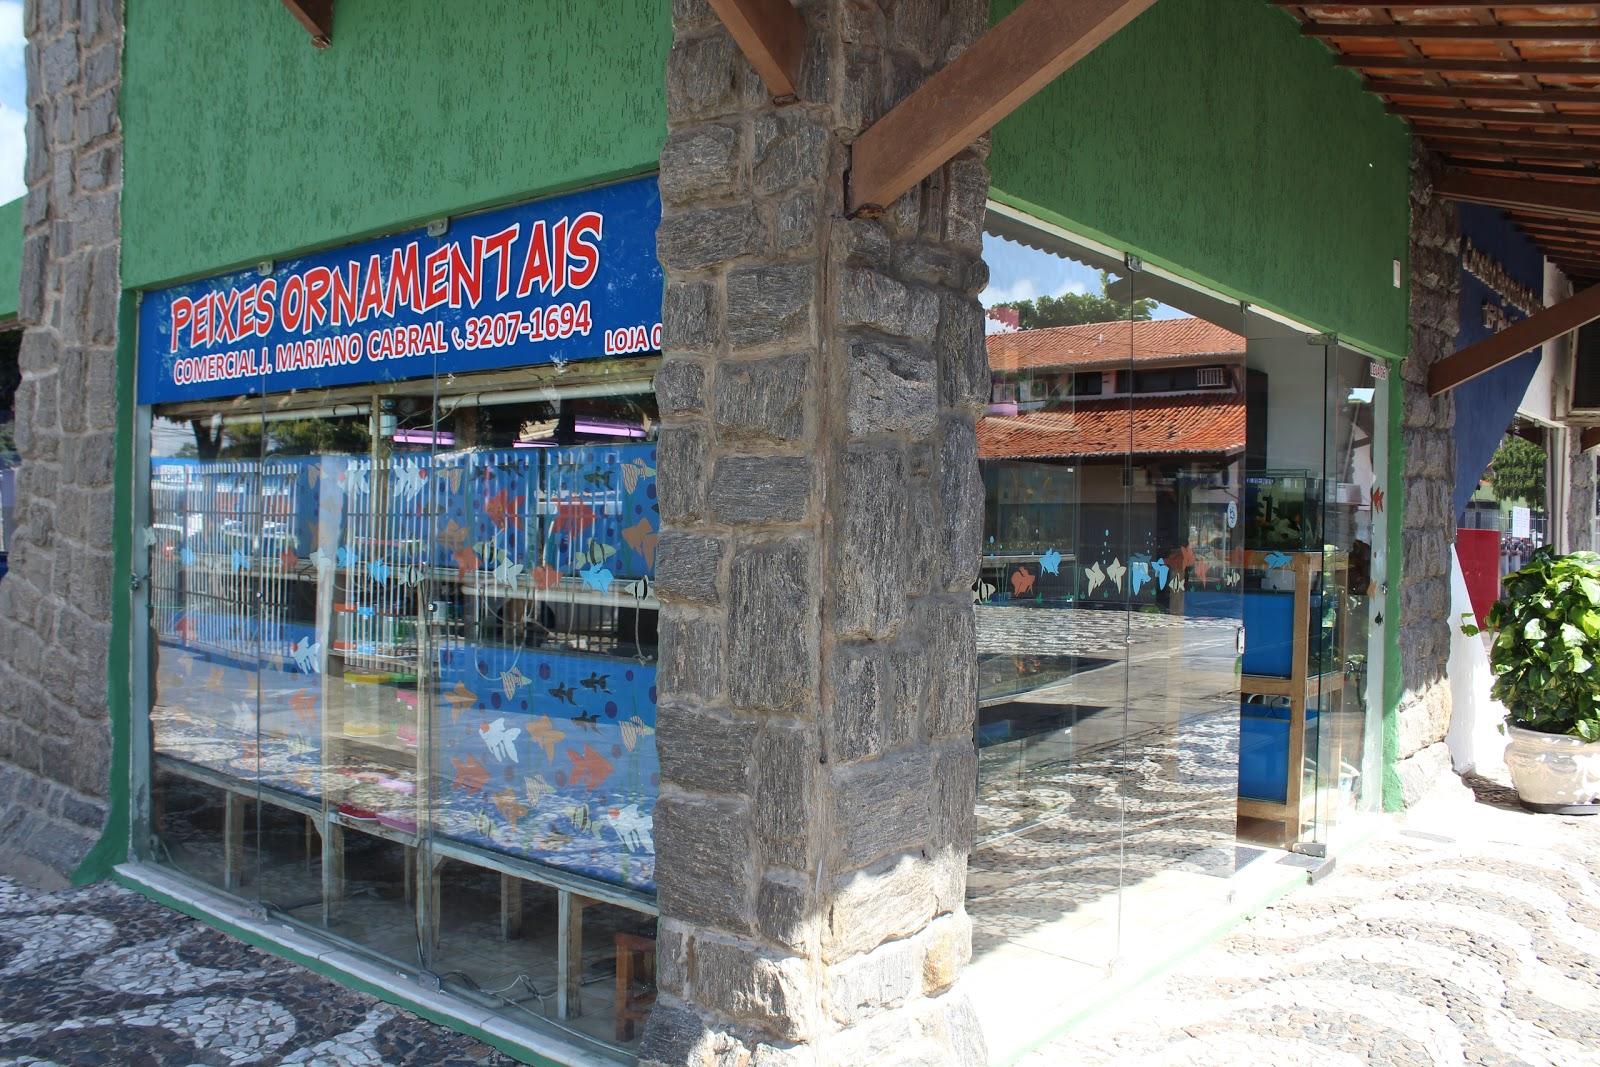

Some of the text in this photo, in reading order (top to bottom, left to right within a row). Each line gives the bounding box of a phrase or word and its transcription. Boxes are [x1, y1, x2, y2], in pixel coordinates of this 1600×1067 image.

[171, 212, 602, 353] PEIXES ORNAMENTAIS
[174, 301, 592, 385] COMERCIAL J. MARIANO CABRAL 3207-1694
[605, 325, 650, 355] LOJA
